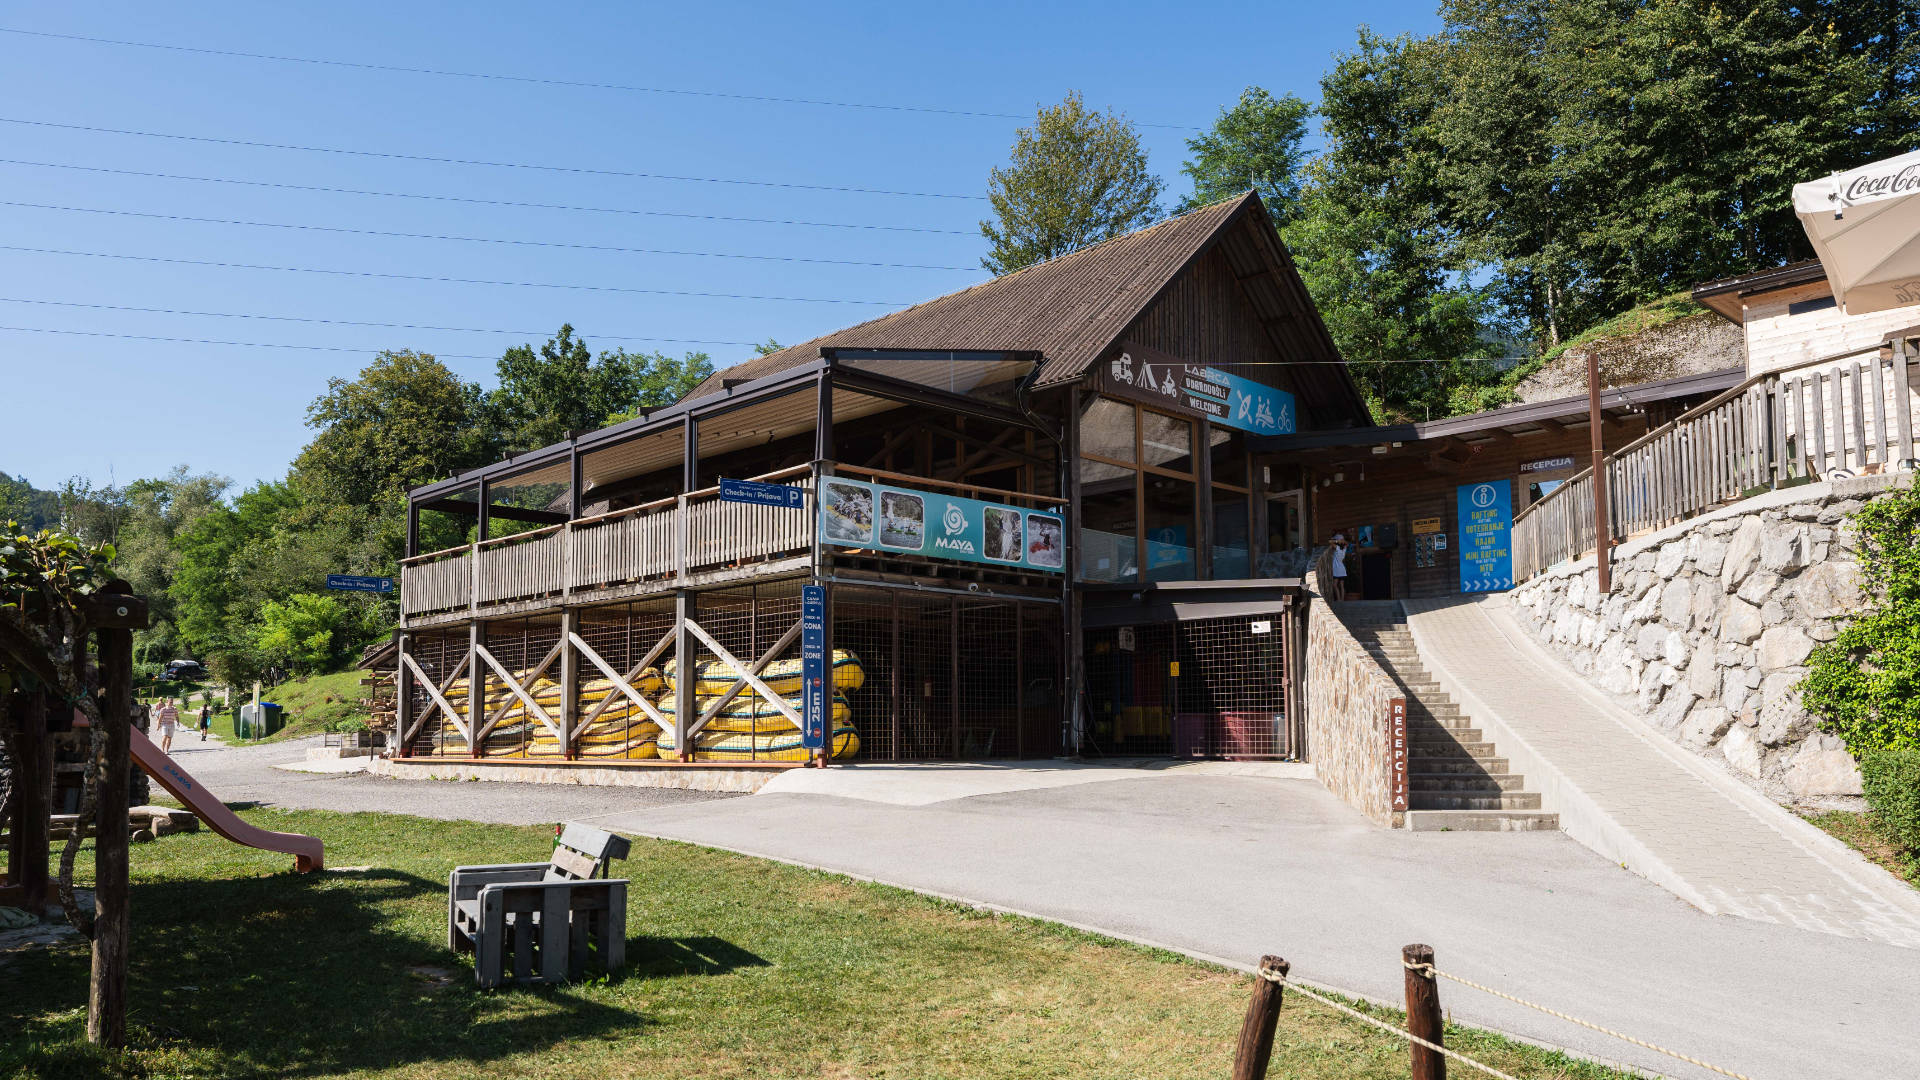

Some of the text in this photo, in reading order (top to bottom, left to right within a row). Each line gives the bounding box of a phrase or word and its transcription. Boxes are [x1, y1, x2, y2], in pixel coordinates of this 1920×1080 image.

[1846, 164, 1920, 200] Coca-Co
[1189, 396, 1222, 416] WELCOME
[1520, 457, 1572, 471] RECEPCIJA
[724, 488, 752, 498] Check-in
[758, 492, 781, 500] Prijava
[790, 490, 798, 504] P
[935, 536, 975, 552] MAYA
[382, 580, 390, 590] P
[812, 692, 821, 723] 25m
[1394, 705, 1405, 805] RECEPCIJA
